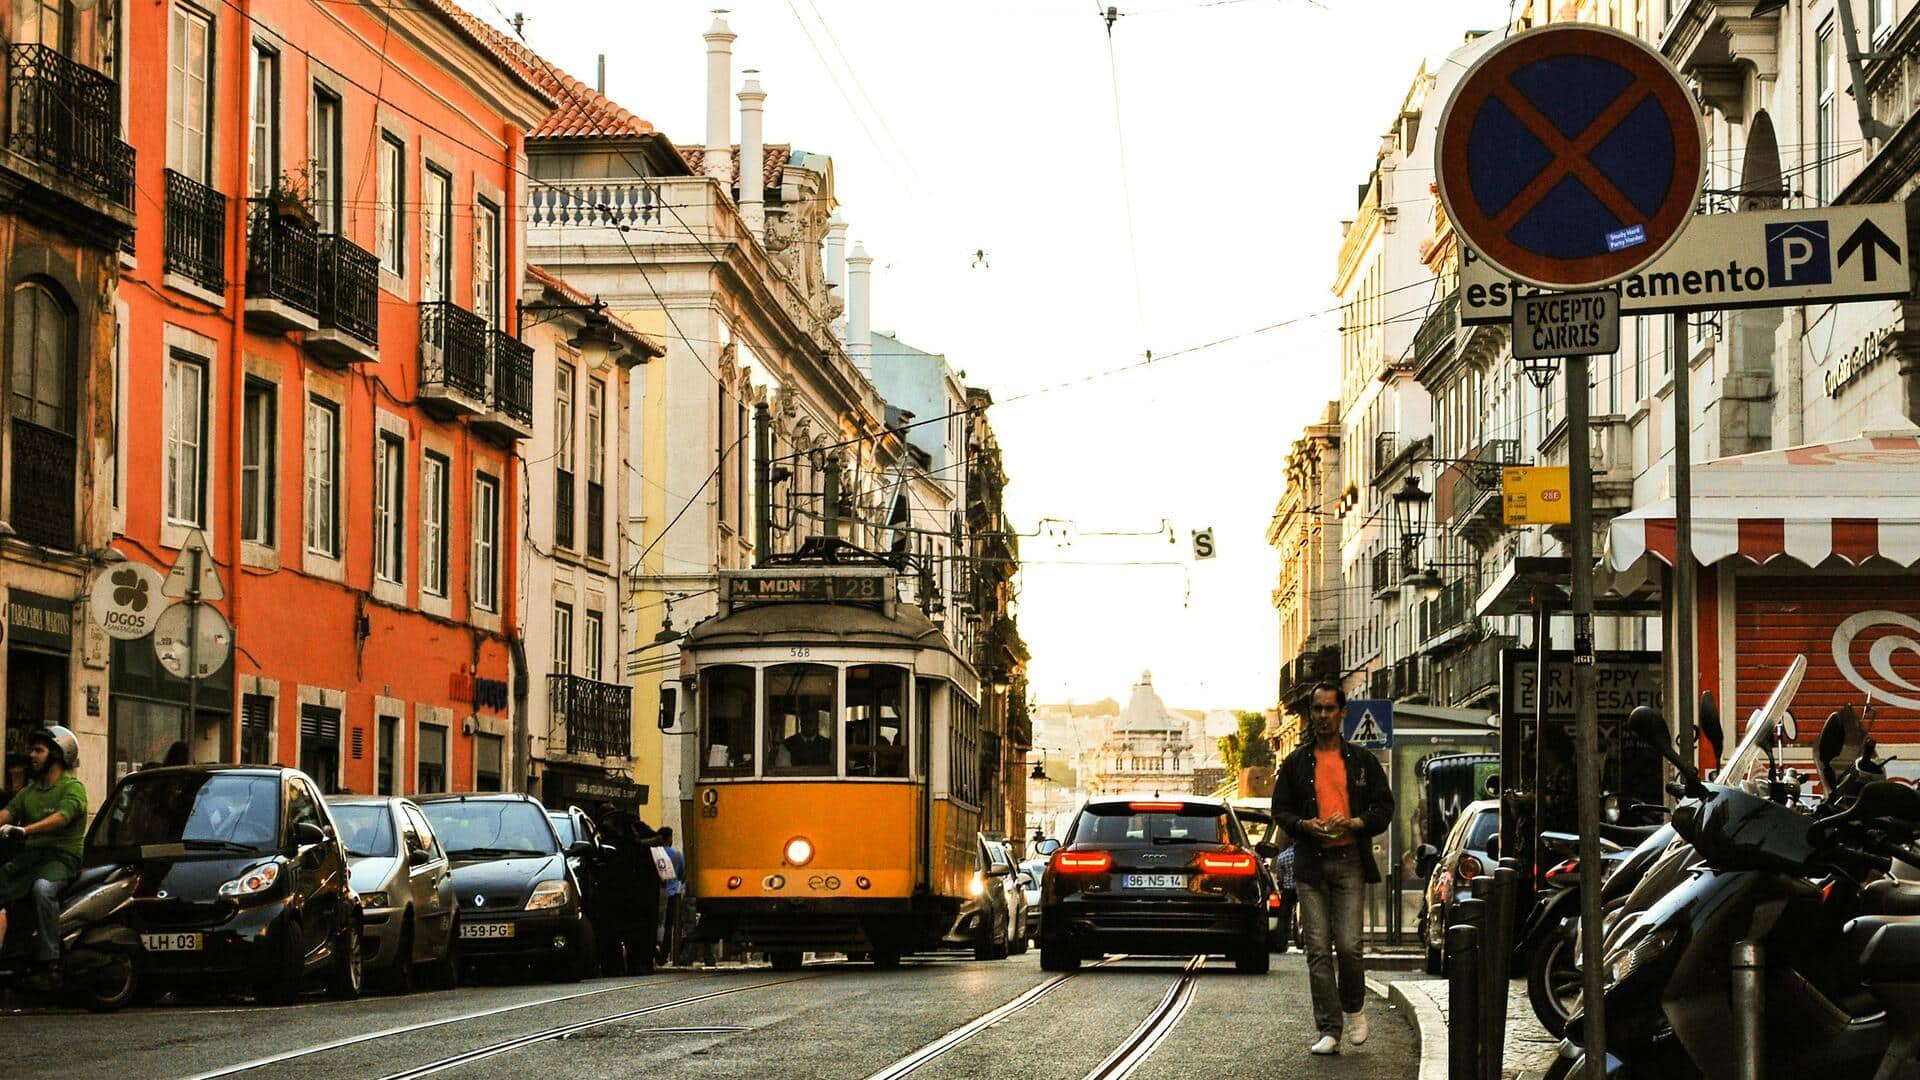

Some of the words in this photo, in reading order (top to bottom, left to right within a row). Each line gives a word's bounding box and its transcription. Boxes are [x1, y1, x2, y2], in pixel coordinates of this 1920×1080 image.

[1526, 296, 1605, 326] EXCEPTO
[1532, 323, 1600, 350] CARRIS
[1196, 534, 1212, 557] S
[845, 578, 875, 596] 28
[104, 611, 146, 628] JOGOS
[790, 648, 810, 658] 568
[1521, 669, 1563, 688] SR
